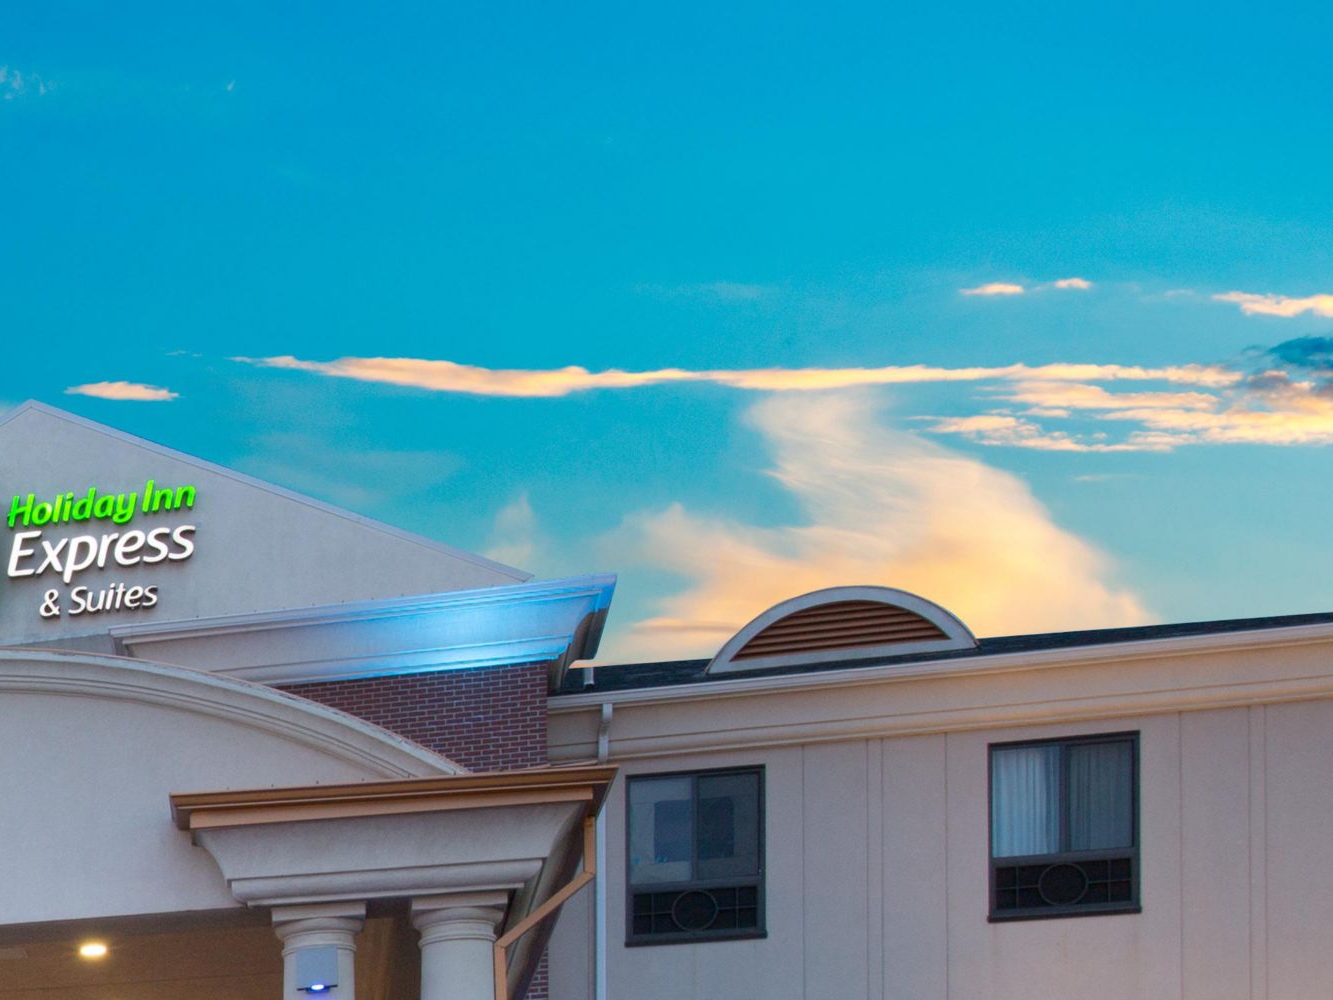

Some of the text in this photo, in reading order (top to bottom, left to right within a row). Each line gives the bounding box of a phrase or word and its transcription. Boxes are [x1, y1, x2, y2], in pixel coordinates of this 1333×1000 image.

[7, 479, 196, 527] Holiday Inn
[7, 525, 196, 583] Express
[39, 583, 158, 618] & Suites
